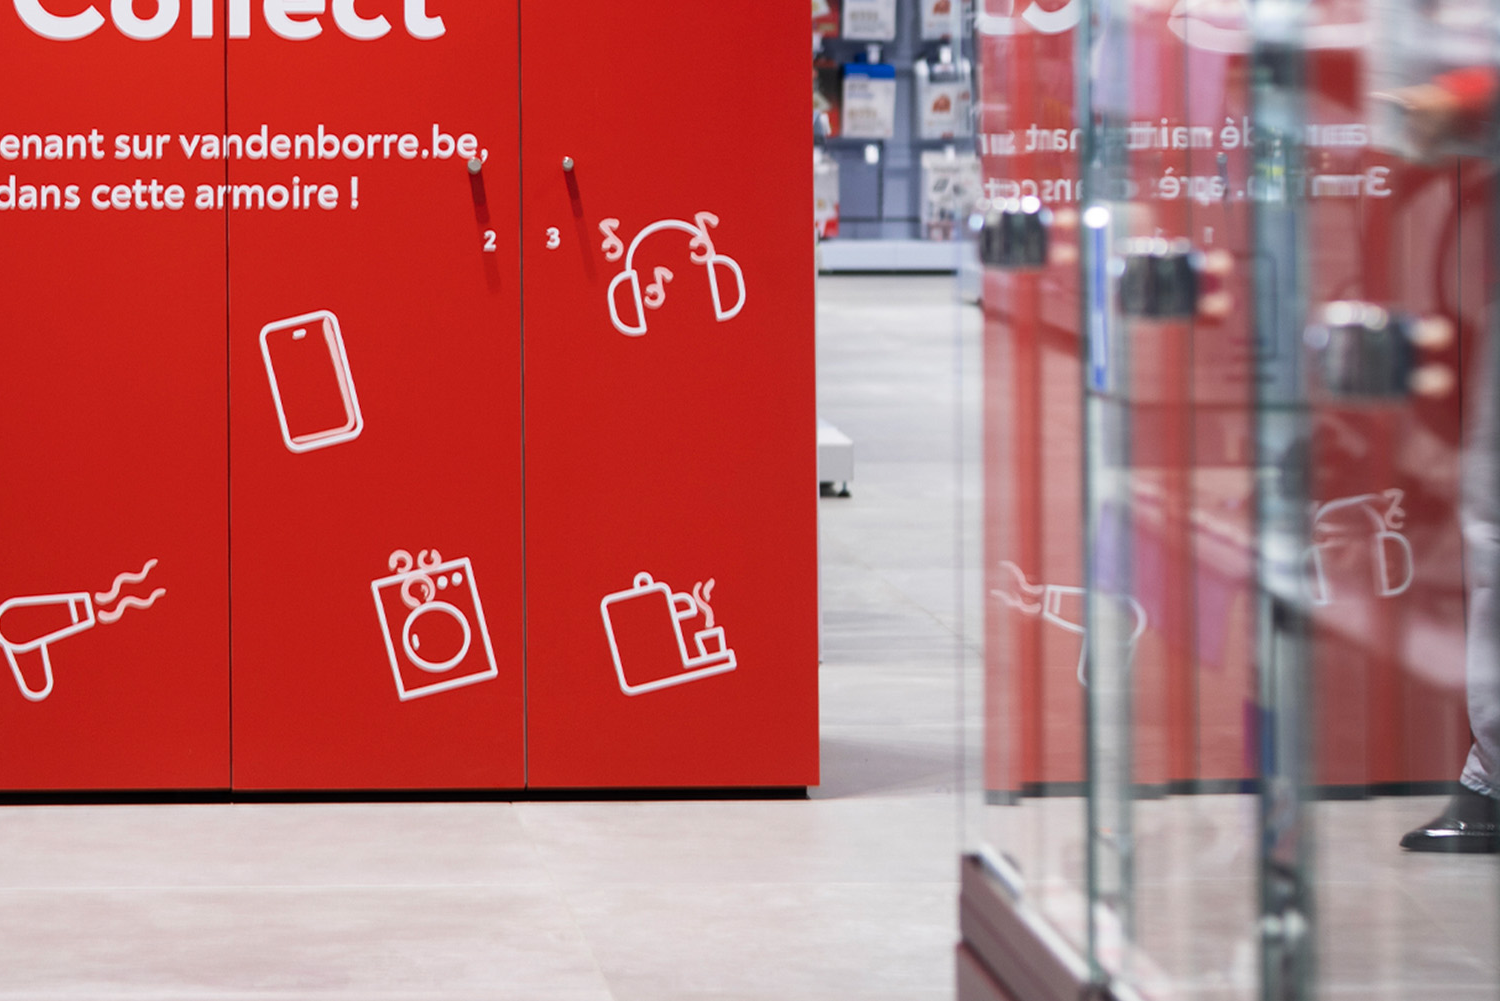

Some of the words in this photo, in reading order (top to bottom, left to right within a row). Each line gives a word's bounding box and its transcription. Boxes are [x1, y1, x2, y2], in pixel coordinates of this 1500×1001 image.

[113, 133, 171, 161] sur
[178, 123, 489, 162] vandenborre.be,
[91, 178, 186, 210] cette
[194, 175, 339, 210] armoire
[350, 176, 360, 210] !
[483, 230, 498, 252] 2
[546, 226, 562, 249] 3
